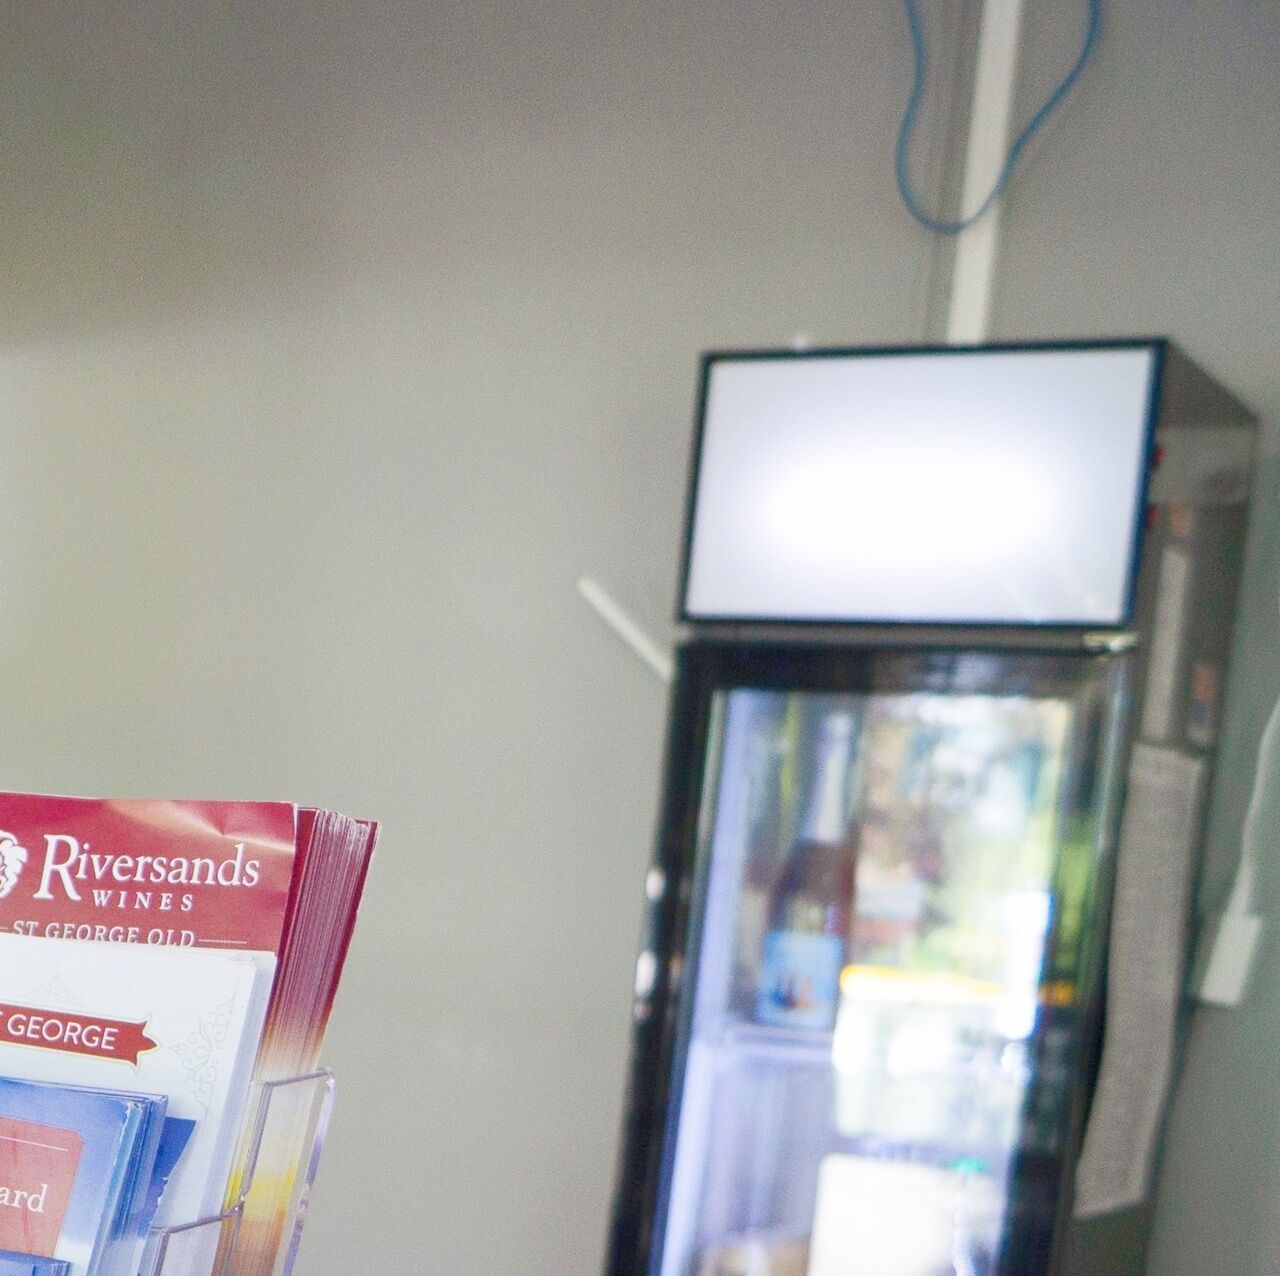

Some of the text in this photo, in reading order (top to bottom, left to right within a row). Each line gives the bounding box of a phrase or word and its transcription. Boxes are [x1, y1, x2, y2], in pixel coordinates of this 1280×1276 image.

[32, 833, 260, 900] Riversands
[92, 889, 193, 911] WINES
[12, 920, 40, 937] ST
[45, 922, 140, 945] GEORGE
[7, 1014, 119, 1050] GEORGE
